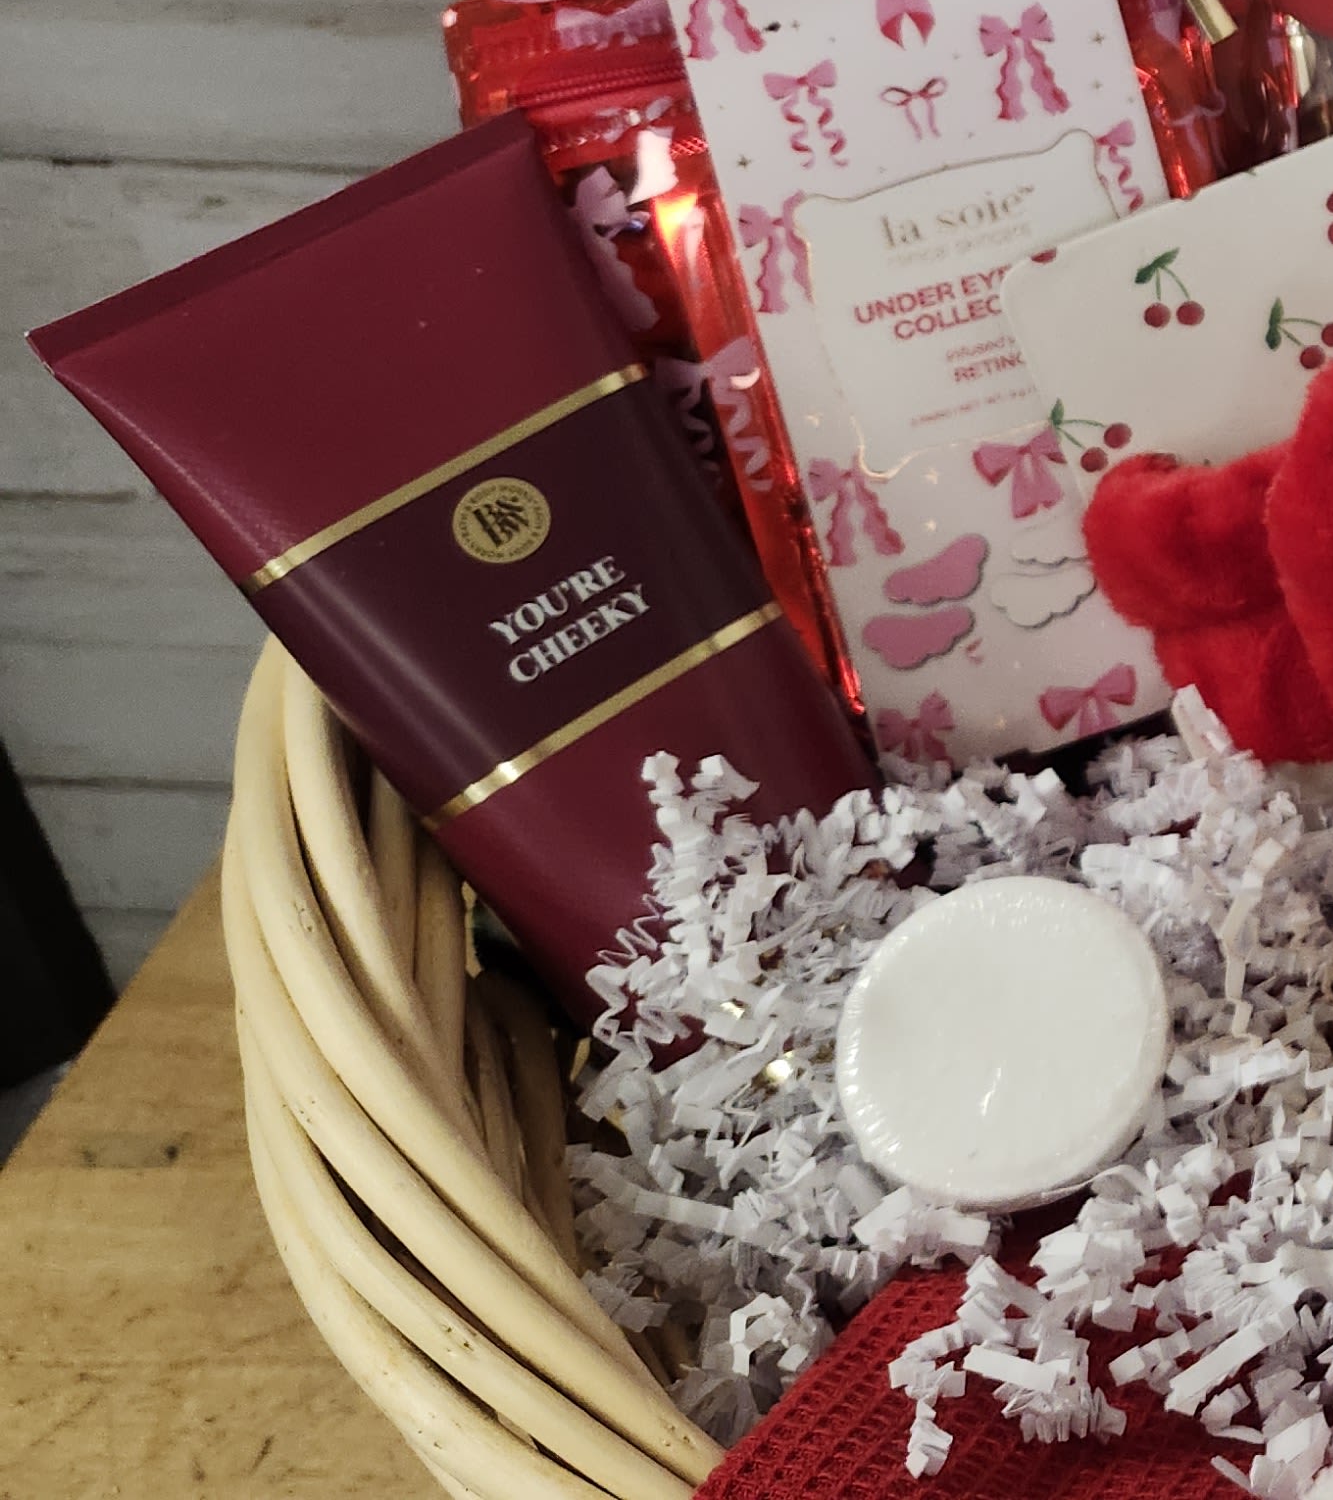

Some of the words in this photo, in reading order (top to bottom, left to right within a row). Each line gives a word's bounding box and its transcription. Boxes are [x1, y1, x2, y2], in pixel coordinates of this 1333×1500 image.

[880, 214, 922, 248] la
[854, 282, 956, 325] UNDER
[488, 555, 627, 645] YOU'RE
[508, 583, 651, 683] CHEEKY
